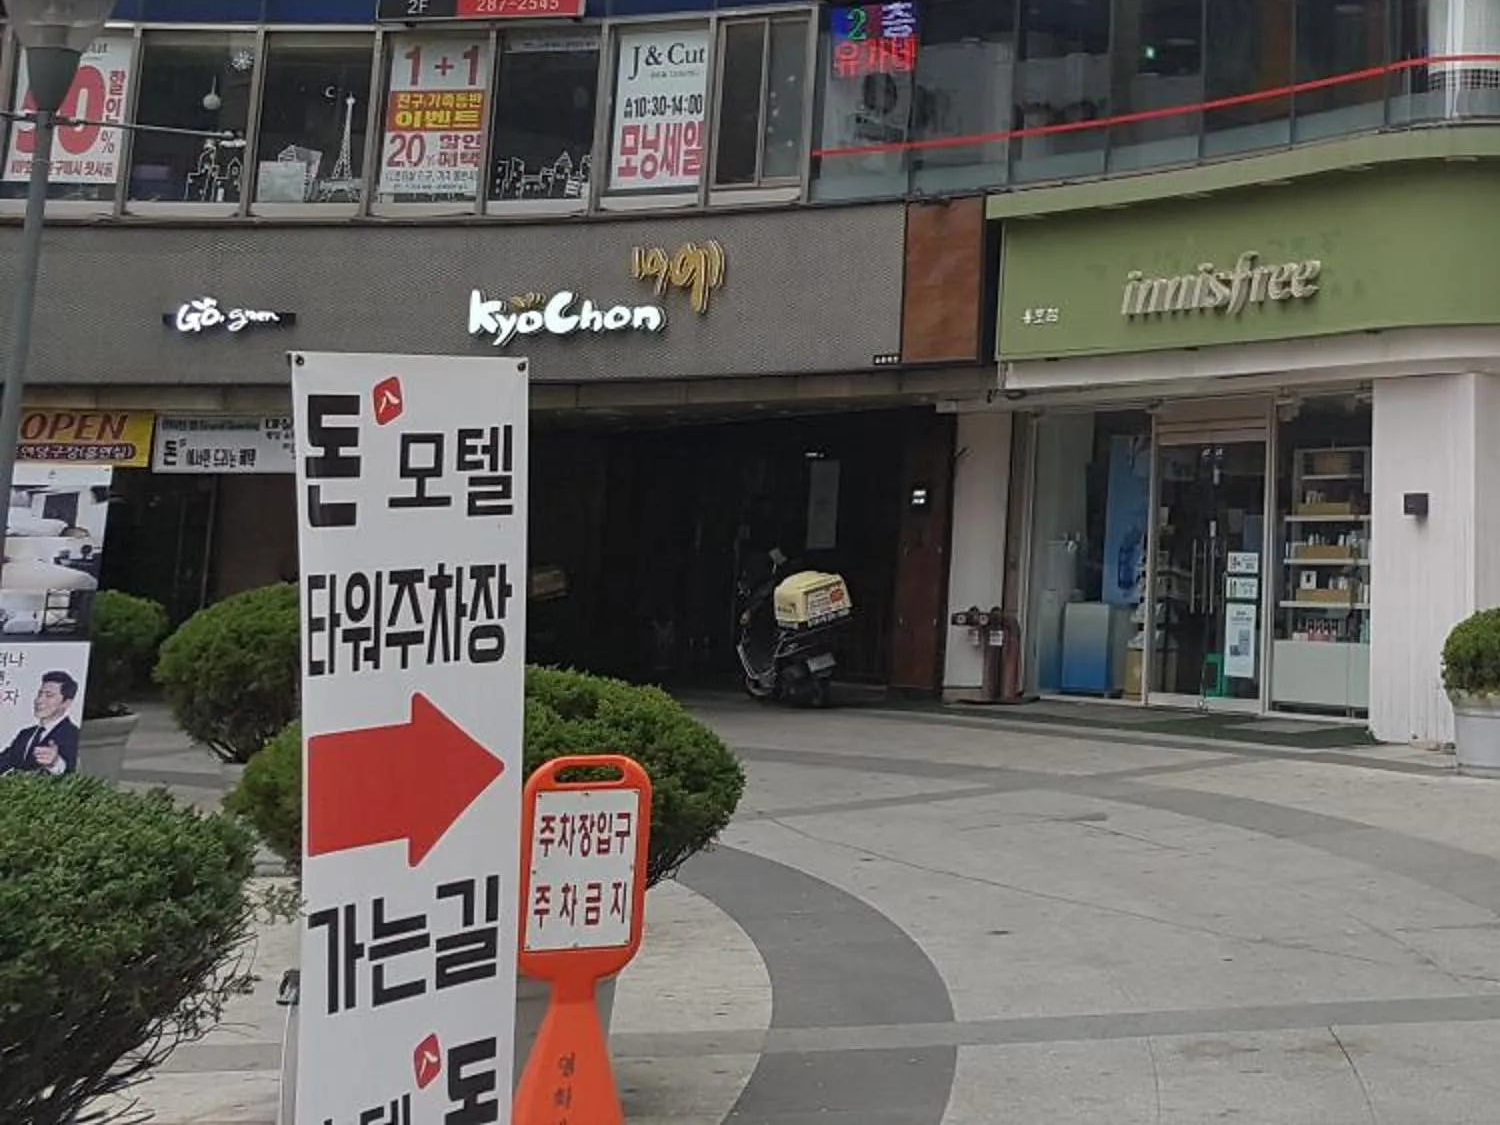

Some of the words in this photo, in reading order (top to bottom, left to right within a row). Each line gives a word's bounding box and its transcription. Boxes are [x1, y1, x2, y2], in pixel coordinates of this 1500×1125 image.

[627, 45, 641, 81] J
[667, 41, 706, 66] Cut
[395, 110, 482, 129] 이벤트
[616, 119, 705, 181] 모닝세일
[1120, 250, 1322, 317] innisfree
[19, 412, 129, 441] OPEN
[306, 394, 362, 529] 돈
[388, 424, 514, 518] 모텔
[306, 561, 513, 677] 타워주차장
[537, 808, 634, 861] 주차장입구
[532, 879, 629, 929] 주차금지
[306, 875, 500, 1017] 가는길
